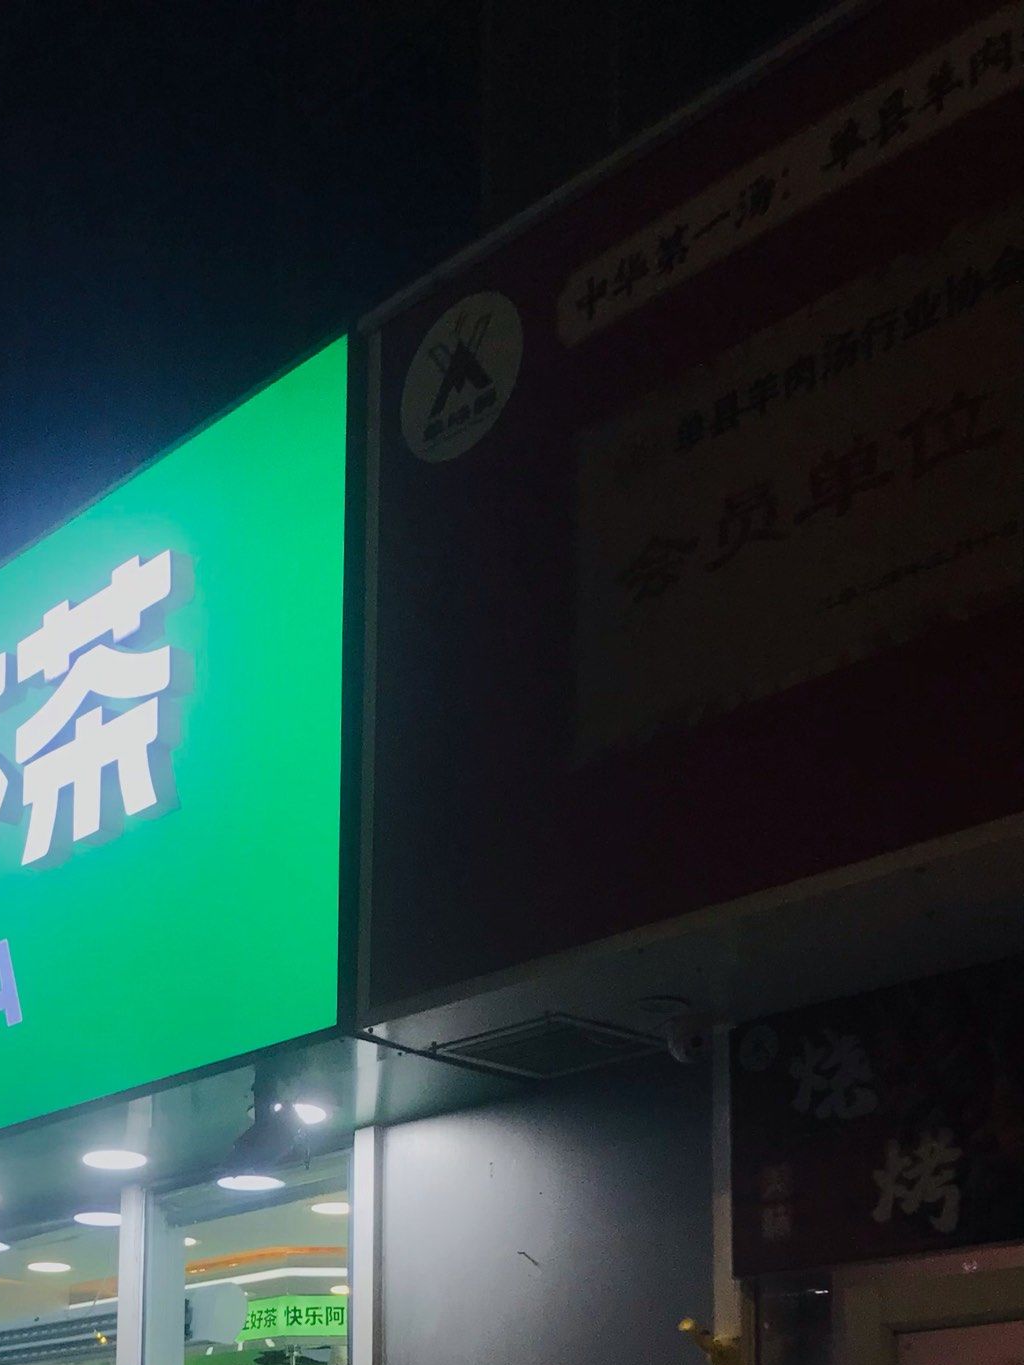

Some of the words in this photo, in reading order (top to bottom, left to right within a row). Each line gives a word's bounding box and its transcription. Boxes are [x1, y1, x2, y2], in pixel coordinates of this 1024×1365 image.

[819, 28, 1024, 171] 单县羊肉
[284, 1306, 345, 1326] 快乐阿
